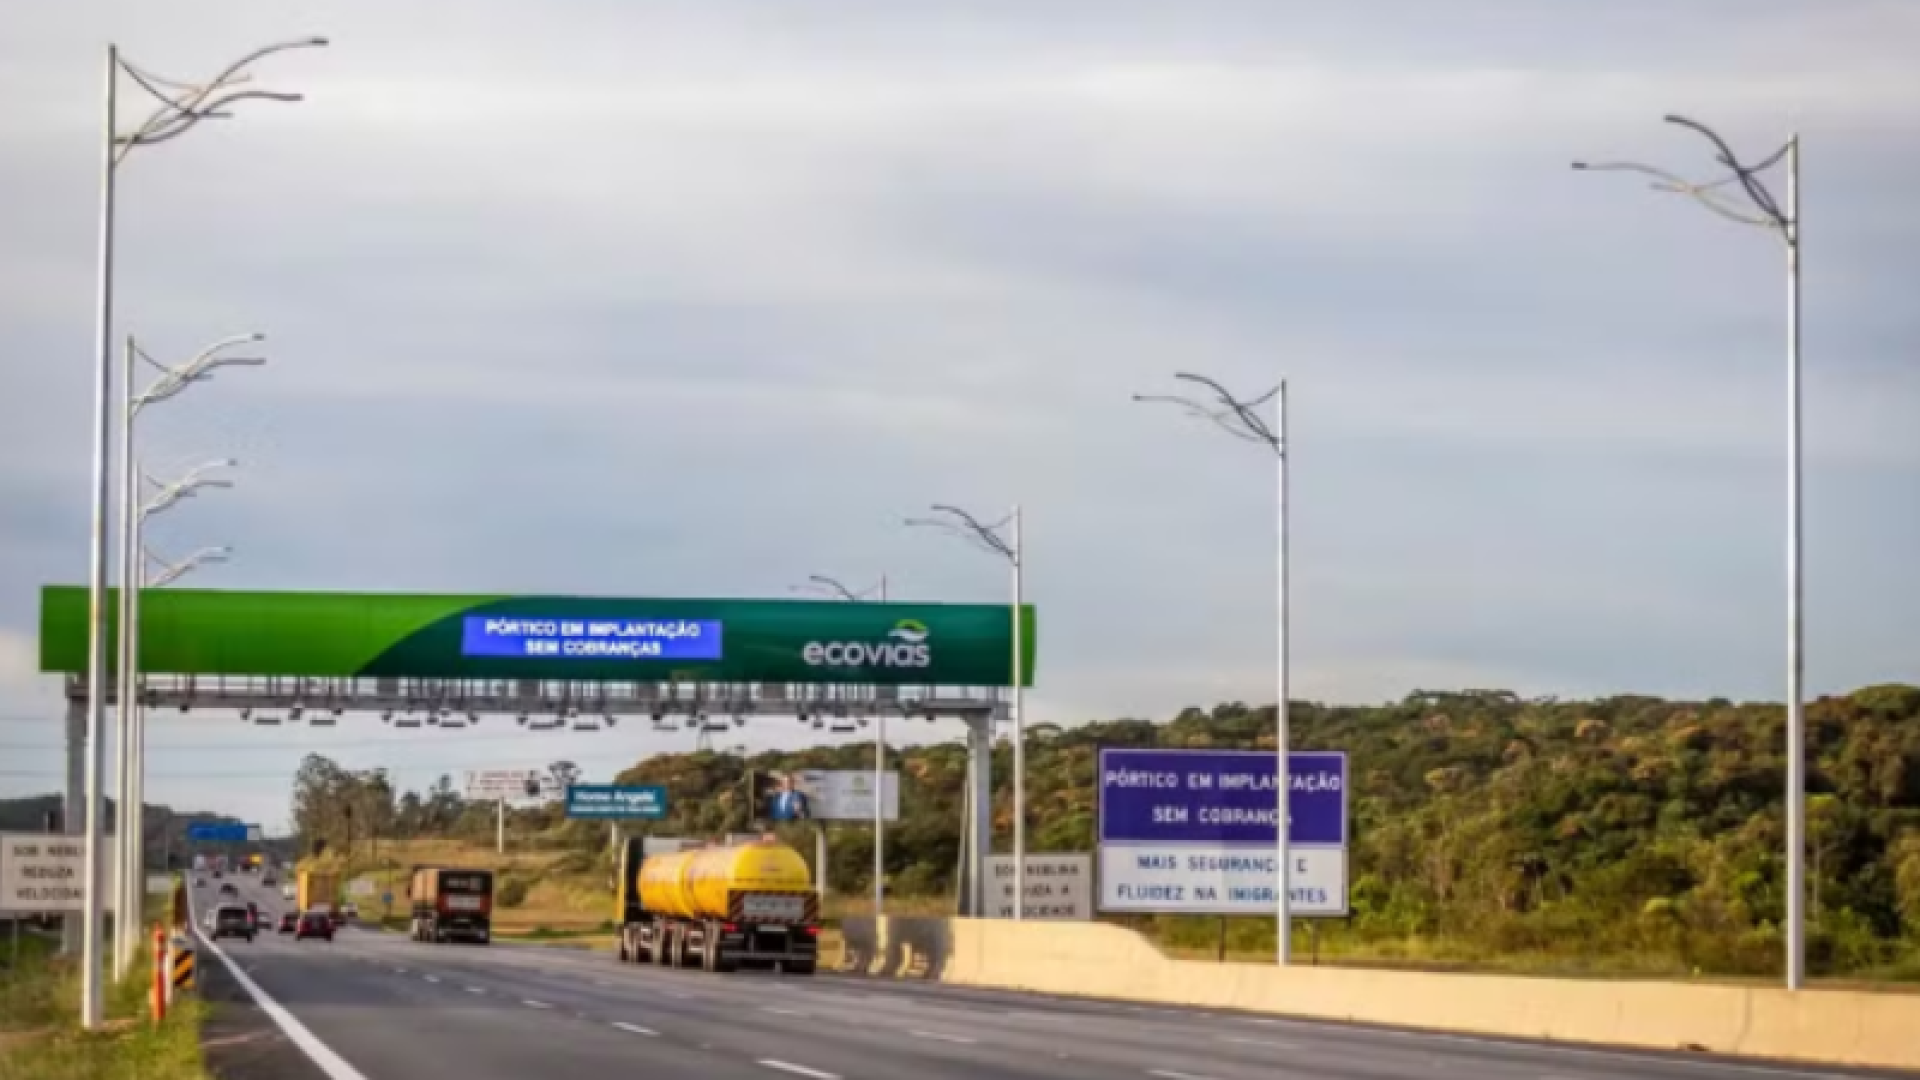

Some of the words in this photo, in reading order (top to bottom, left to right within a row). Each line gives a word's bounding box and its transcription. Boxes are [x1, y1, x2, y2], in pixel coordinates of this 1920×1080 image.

[485, 617, 557, 635] PÓRTICO
[561, 620, 584, 636] EM
[588, 619, 701, 638] IMPLANTAÇÃO
[526, 639, 559, 655] SEM
[563, 640, 662, 657] COBRANÇAS
[803, 641, 930, 667] ecovias
[1105, 766, 1179, 788] PÓRTICO
[1187, 772, 1212, 789] EM
[1219, 771, 1341, 793] IMPLANAÇÃO
[1152, 805, 1188, 823] SEM
[1198, 807, 1293, 828] COBRANÇ
[1137, 855, 1177, 869] MAIS
[1187, 855, 1278, 873] SEGURANÇ
[1117, 883, 1184, 900] FLUIDEZ
[1193, 886, 1217, 900] NA
